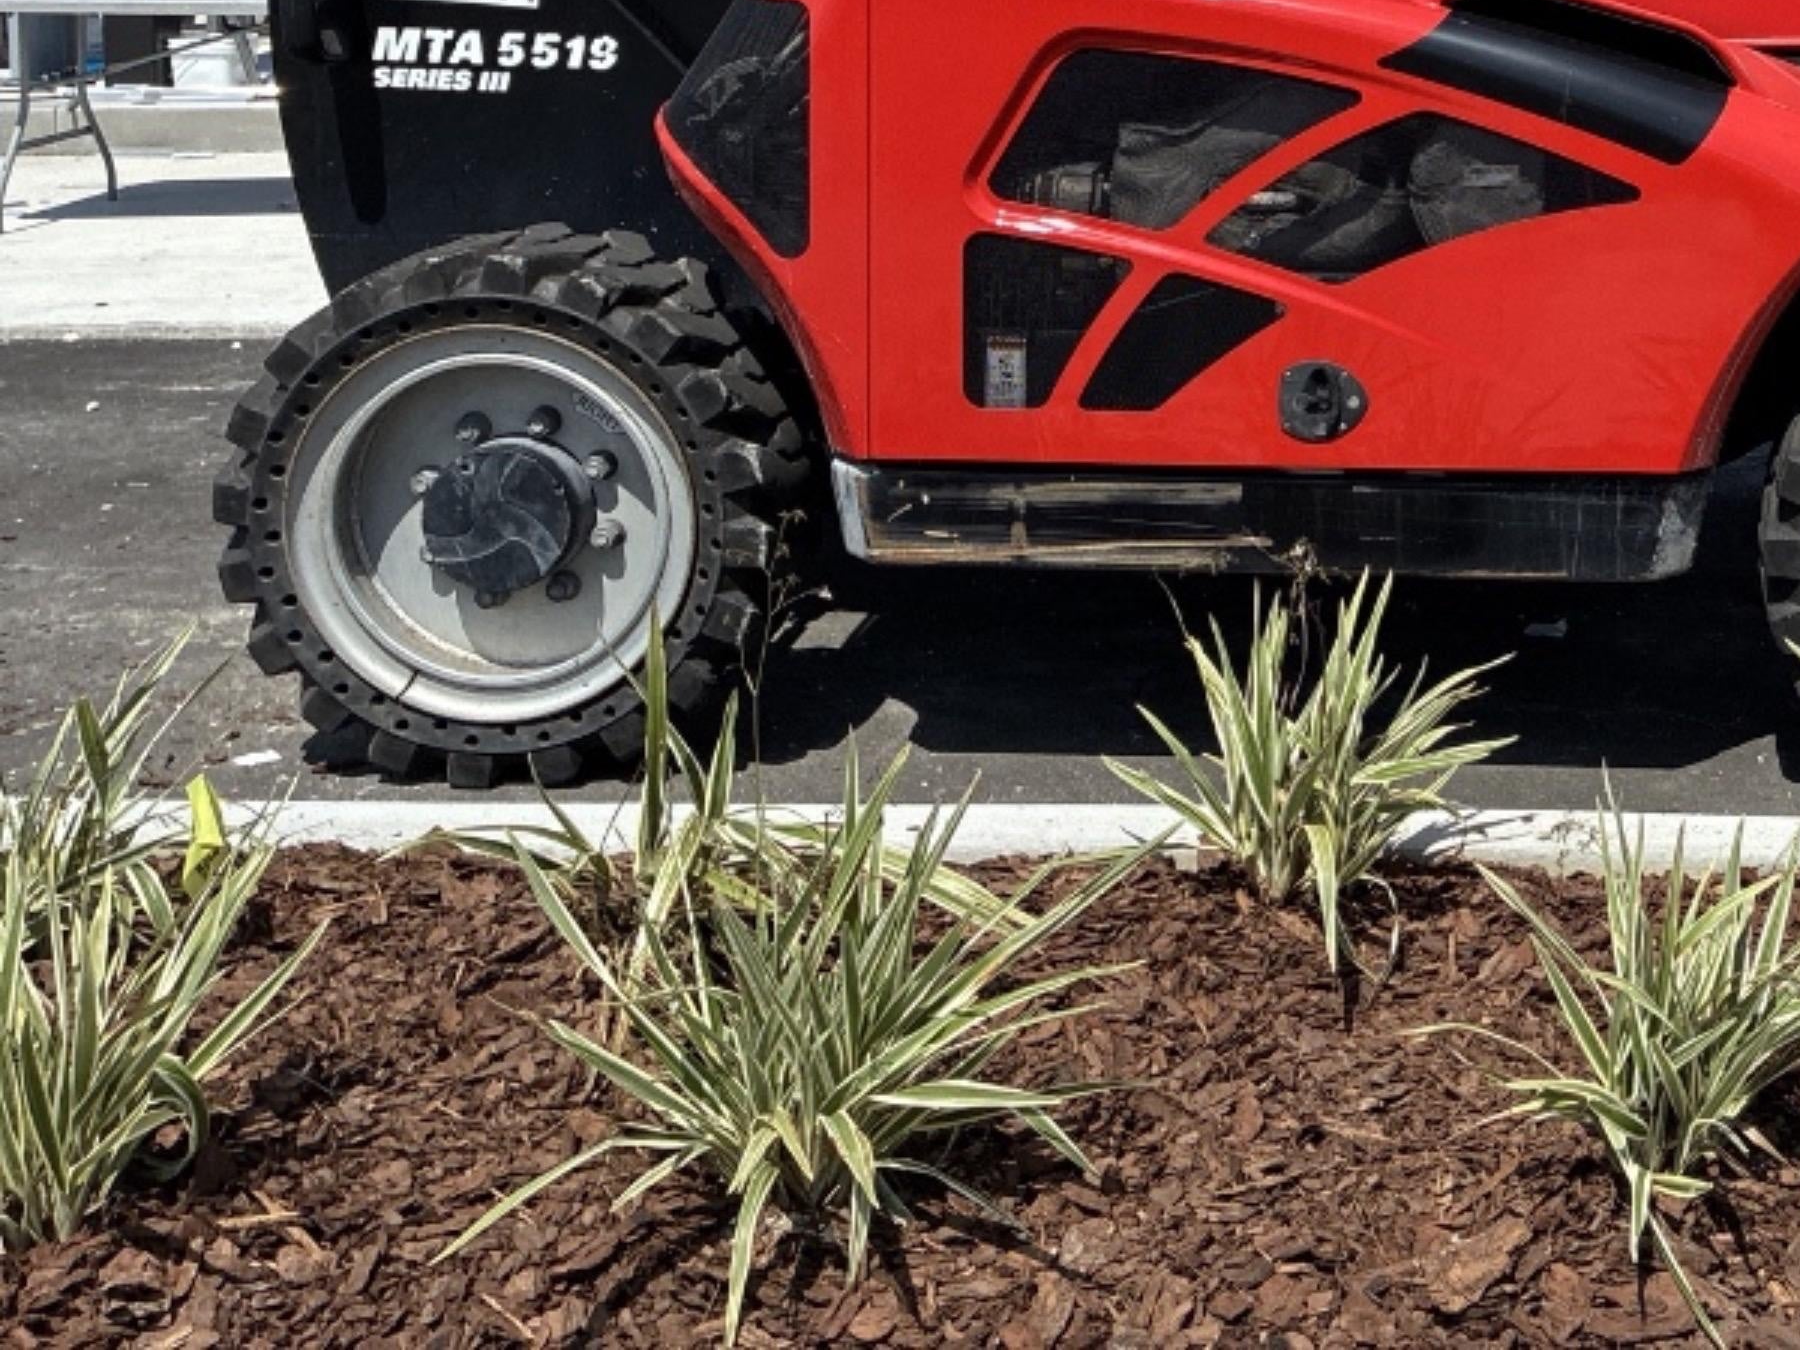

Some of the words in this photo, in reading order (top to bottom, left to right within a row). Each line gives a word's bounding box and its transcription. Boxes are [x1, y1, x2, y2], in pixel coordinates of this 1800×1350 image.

[371, 26, 484, 66] MTA
[497, 31, 619, 71] 5519
[373, 66, 474, 91] SERIES
[477, 71, 511, 94] III
